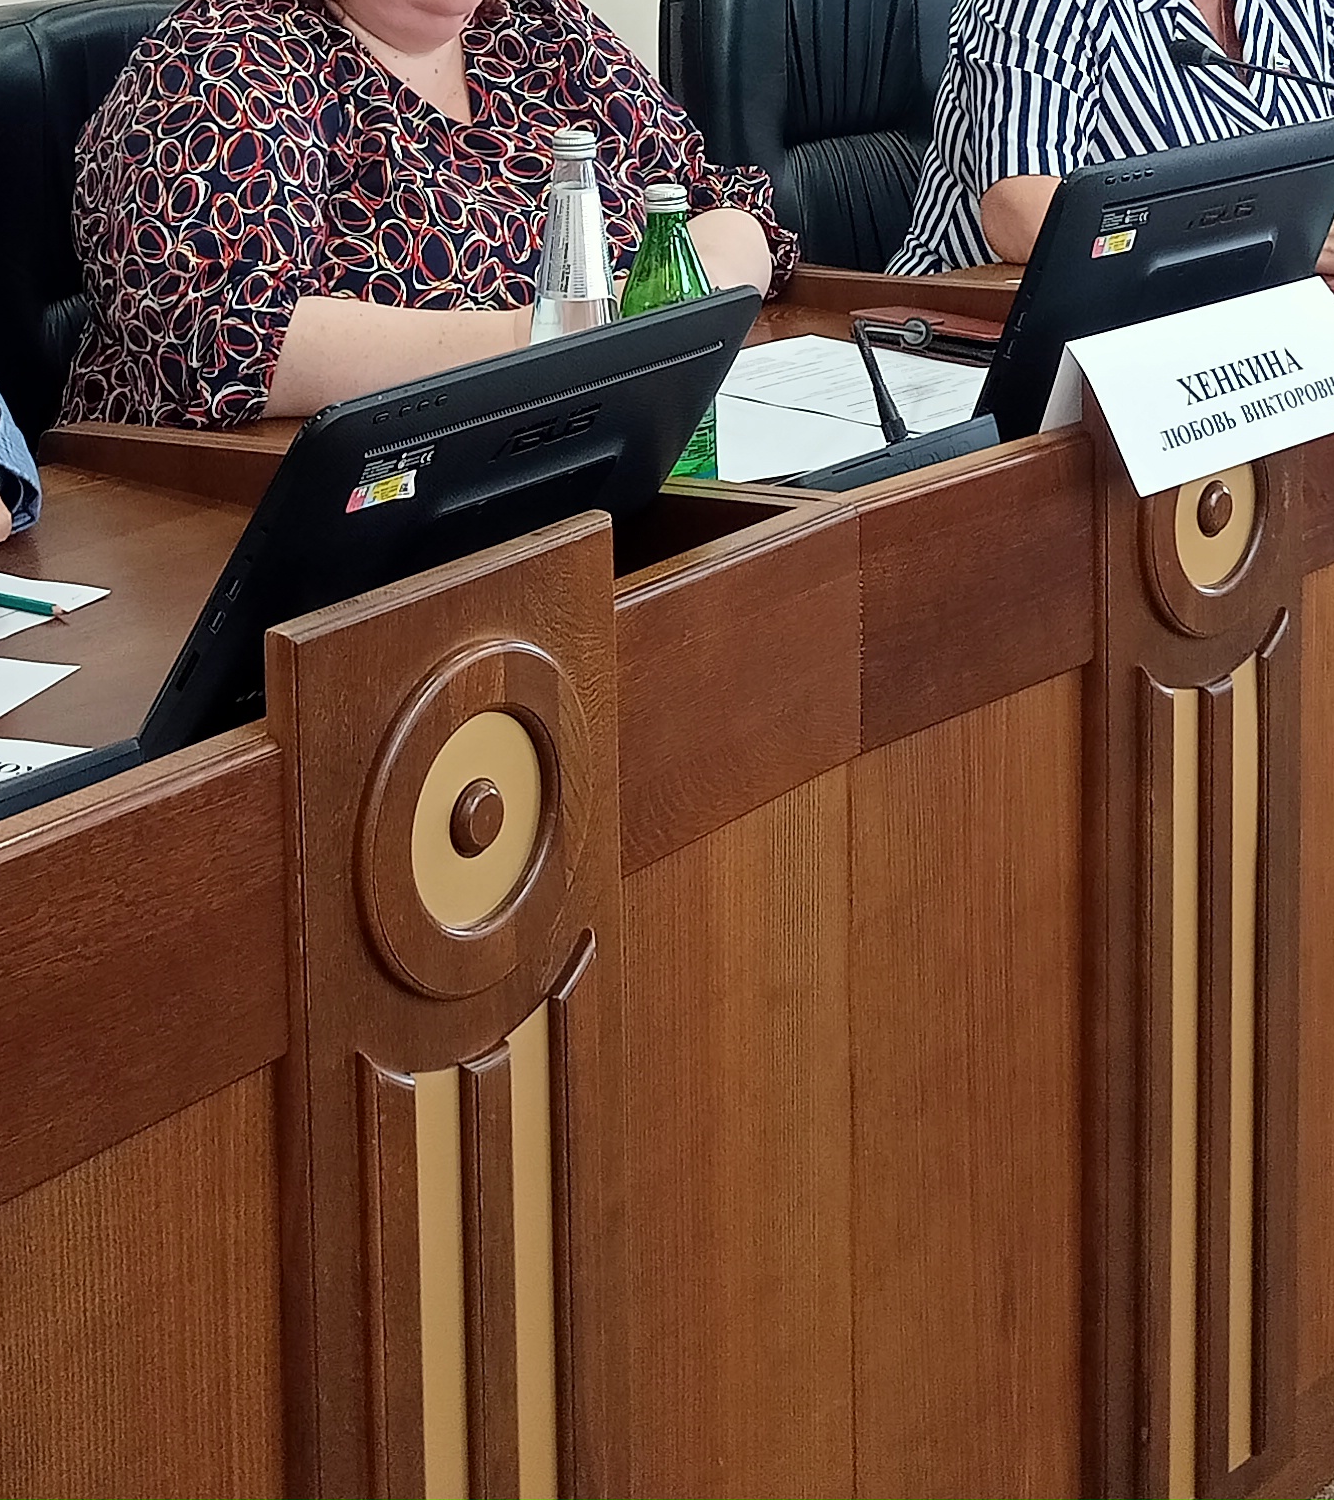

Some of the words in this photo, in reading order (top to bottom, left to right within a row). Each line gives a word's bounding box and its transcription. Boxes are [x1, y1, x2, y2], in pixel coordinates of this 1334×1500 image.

[1176, 346, 1304, 406] ХЕНКИНА
[488, 402, 603, 463] ASUS
[1159, 410, 1238, 452] ЛЮБОВЬ
